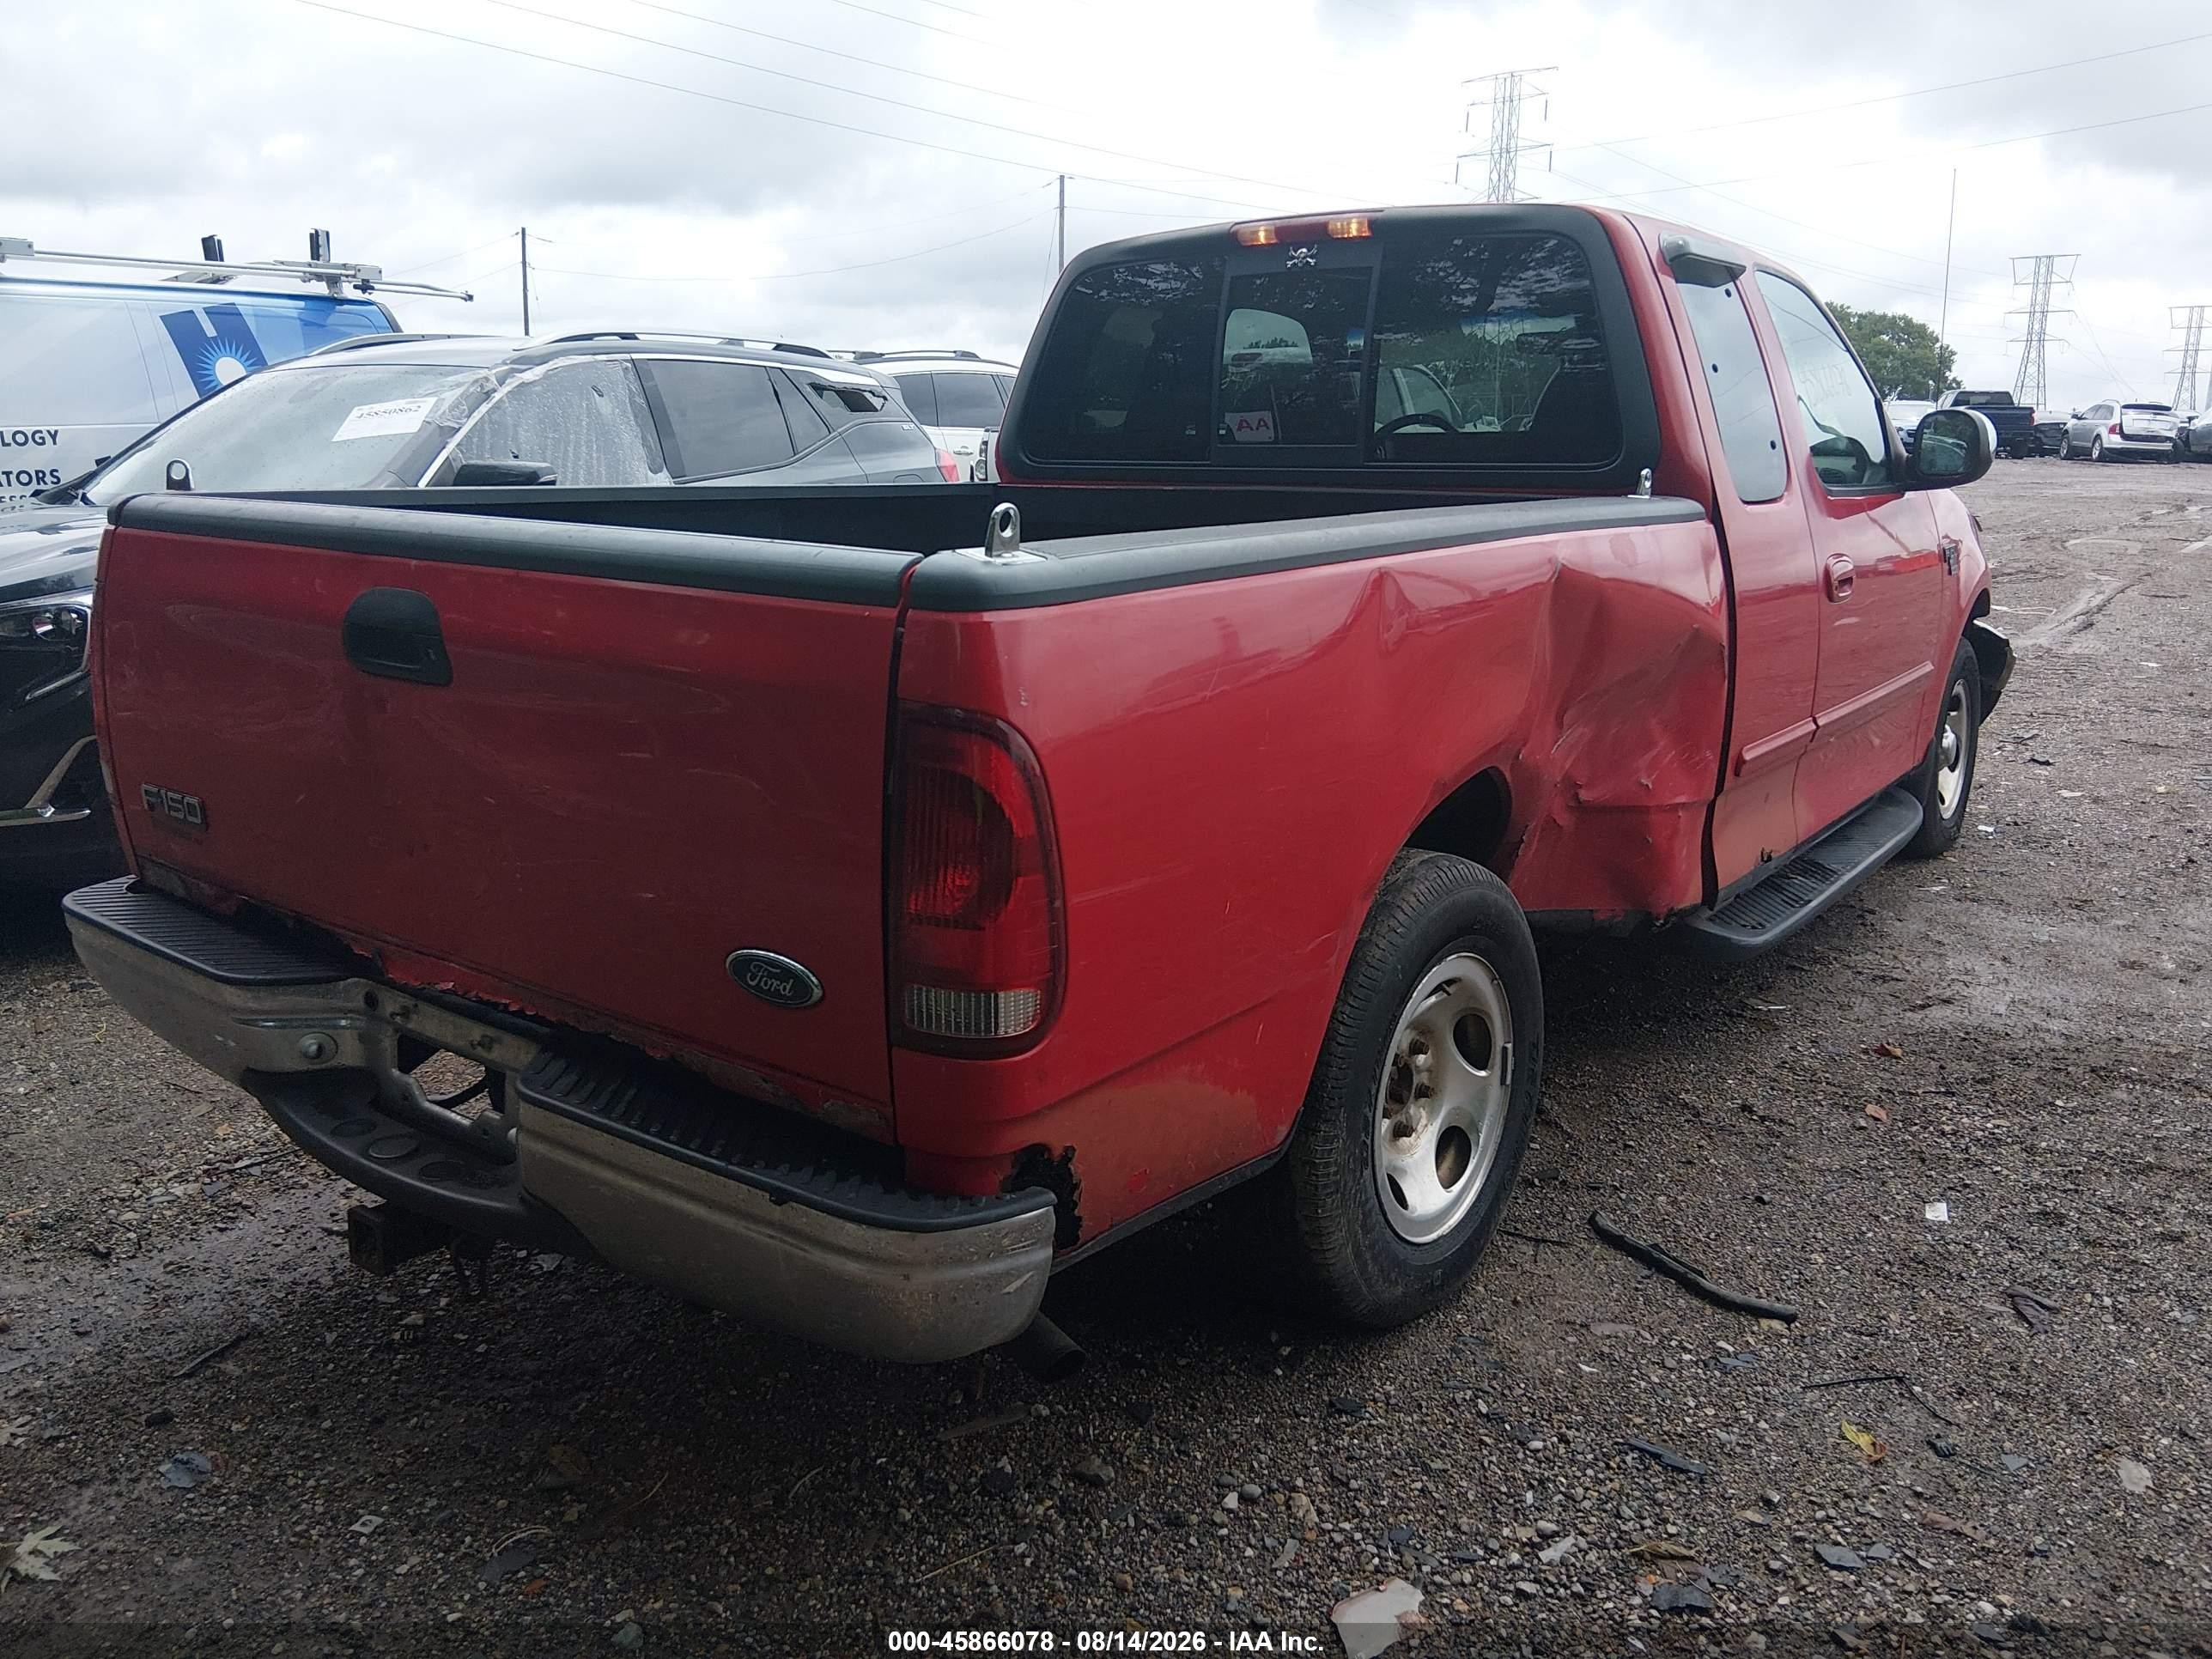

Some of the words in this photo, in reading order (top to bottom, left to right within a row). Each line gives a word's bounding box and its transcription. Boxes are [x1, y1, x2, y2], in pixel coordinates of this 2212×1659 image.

[0, 429, 58, 447] LOGY
[0, 469, 61, 487] TORS
[141, 783, 202, 824] F150
[746, 961, 796, 996] Ford
